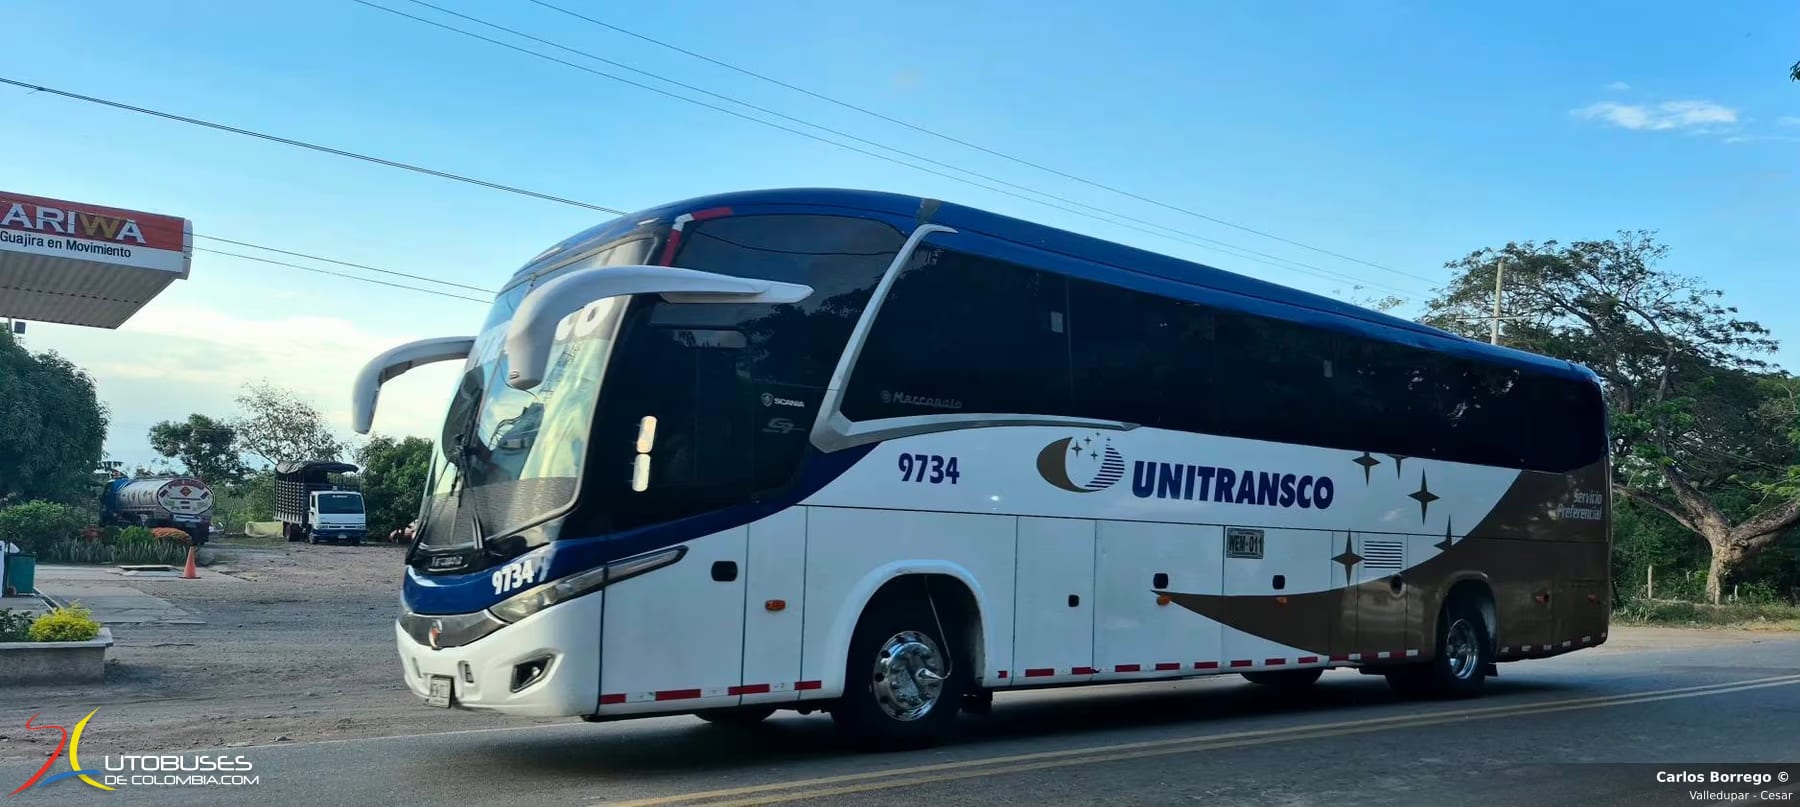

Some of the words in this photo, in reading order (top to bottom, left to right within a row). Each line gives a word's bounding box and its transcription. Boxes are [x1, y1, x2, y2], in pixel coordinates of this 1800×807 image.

[0, 230, 44, 247] Guajira
[47, 239, 62, 249] en
[66, 240, 131, 258] Movimiento
[774, 397, 805, 409] SCANIA
[898, 453, 960, 484] 9734
[1132, 460, 1334, 509] UNITRANSCO
[1574, 489, 1602, 504] Servicio
[1557, 504, 1602, 520] Preferencial
[491, 560, 535, 595] 9734
